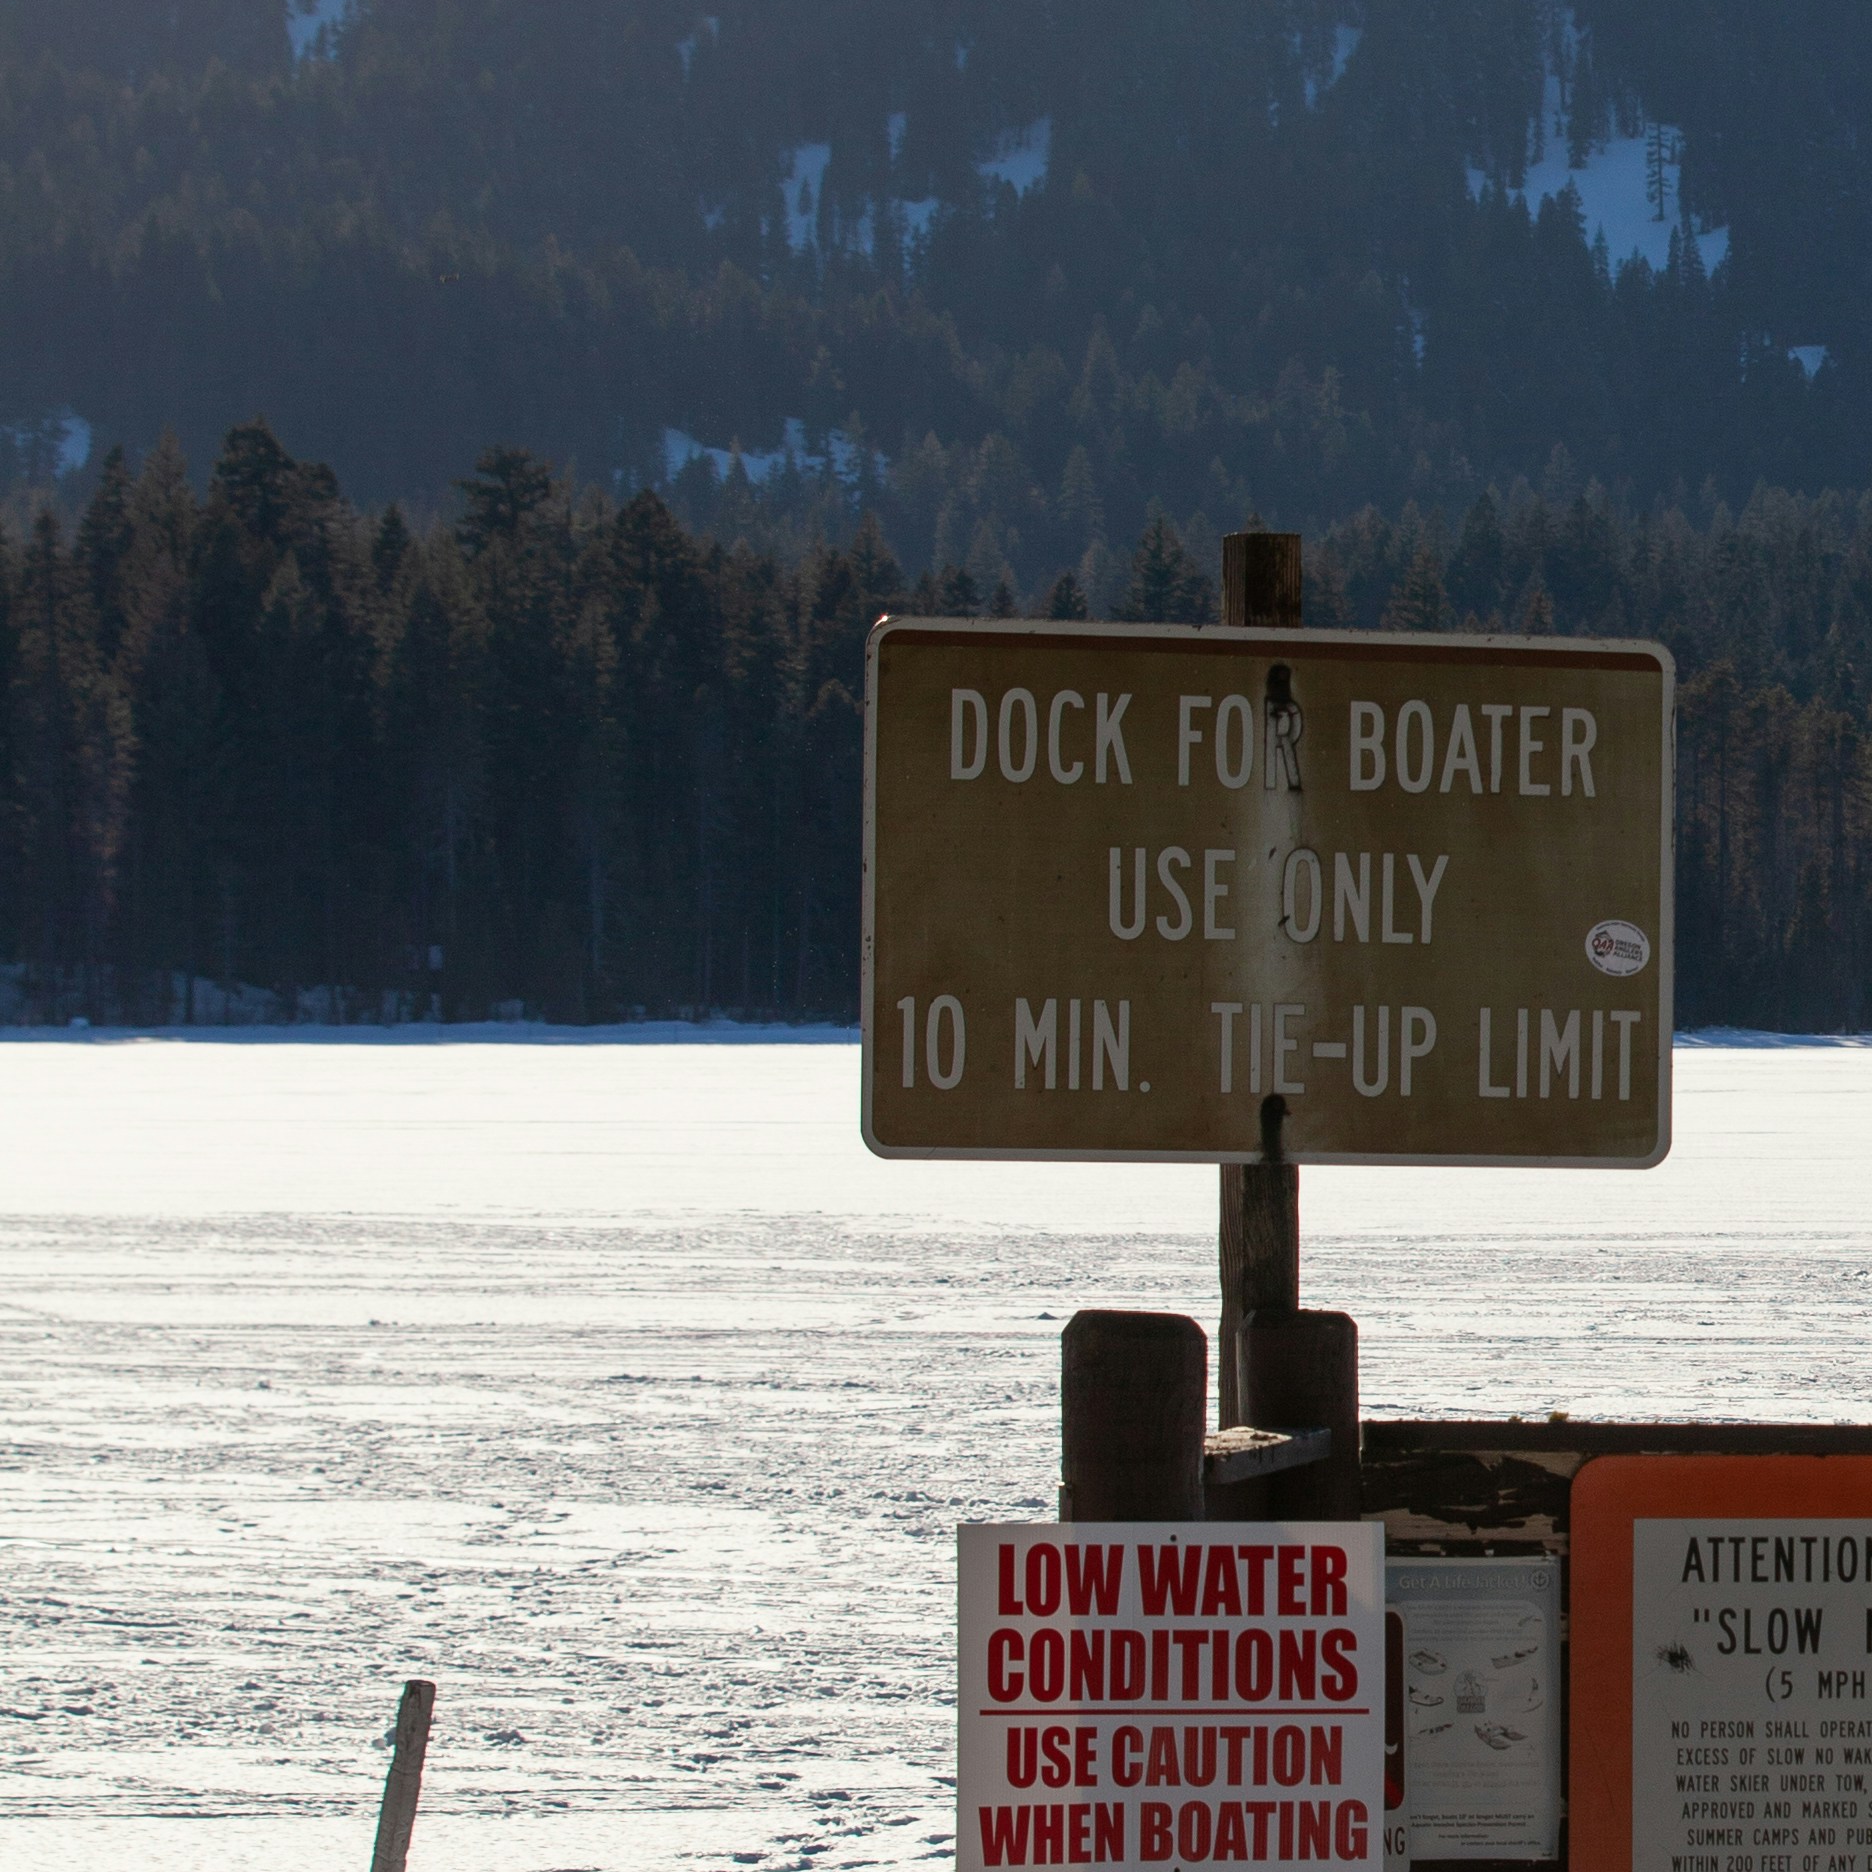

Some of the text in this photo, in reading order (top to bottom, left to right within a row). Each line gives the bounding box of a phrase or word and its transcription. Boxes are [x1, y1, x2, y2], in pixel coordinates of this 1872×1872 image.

[950, 688, 1596, 795] DOCK FOR BOATER
[1109, 847, 1451, 945] USE ONLY
[897, 995, 1641, 1098] 10 MIN. TIE-UP LIMIT
[998, 1543, 1347, 1615] LOW WATER
[1399, 1575, 1525, 1590] Get A Life Jacket!
[1693, 1608, 1822, 1654] "SLOW
[987, 1629, 1357, 1700] CONDITIONS
[1765, 1666, 1793, 1702] (5
[1818, 1670, 1865, 1698] MPH
[1006, 1726, 1097, 1787] USE
[1111, 1726, 1342, 1785] CAUTION
[1671, 1720, 1689, 1738] NO
[1700, 1720, 1754, 1738] PERSON
[1765, 1721, 1809, 1738] SHALL
[1677, 1747, 1728, 1765] EXCESS
[1739, 1747, 1756, 1765] OF
[1767, 1747, 1805, 1764] SLOW
[1815, 1747, 1833, 1764] NO
[1675, 1774, 1719, 1792] WATER
[1730, 1774, 1769, 1791] SKIER
[1780, 1774, 1825, 1791] UNDER
[1835, 1774, 1867, 1793] TOW,
[978, 1803, 1124, 1865] WHEN
[1140, 1801, 1367, 1860] BOATING
